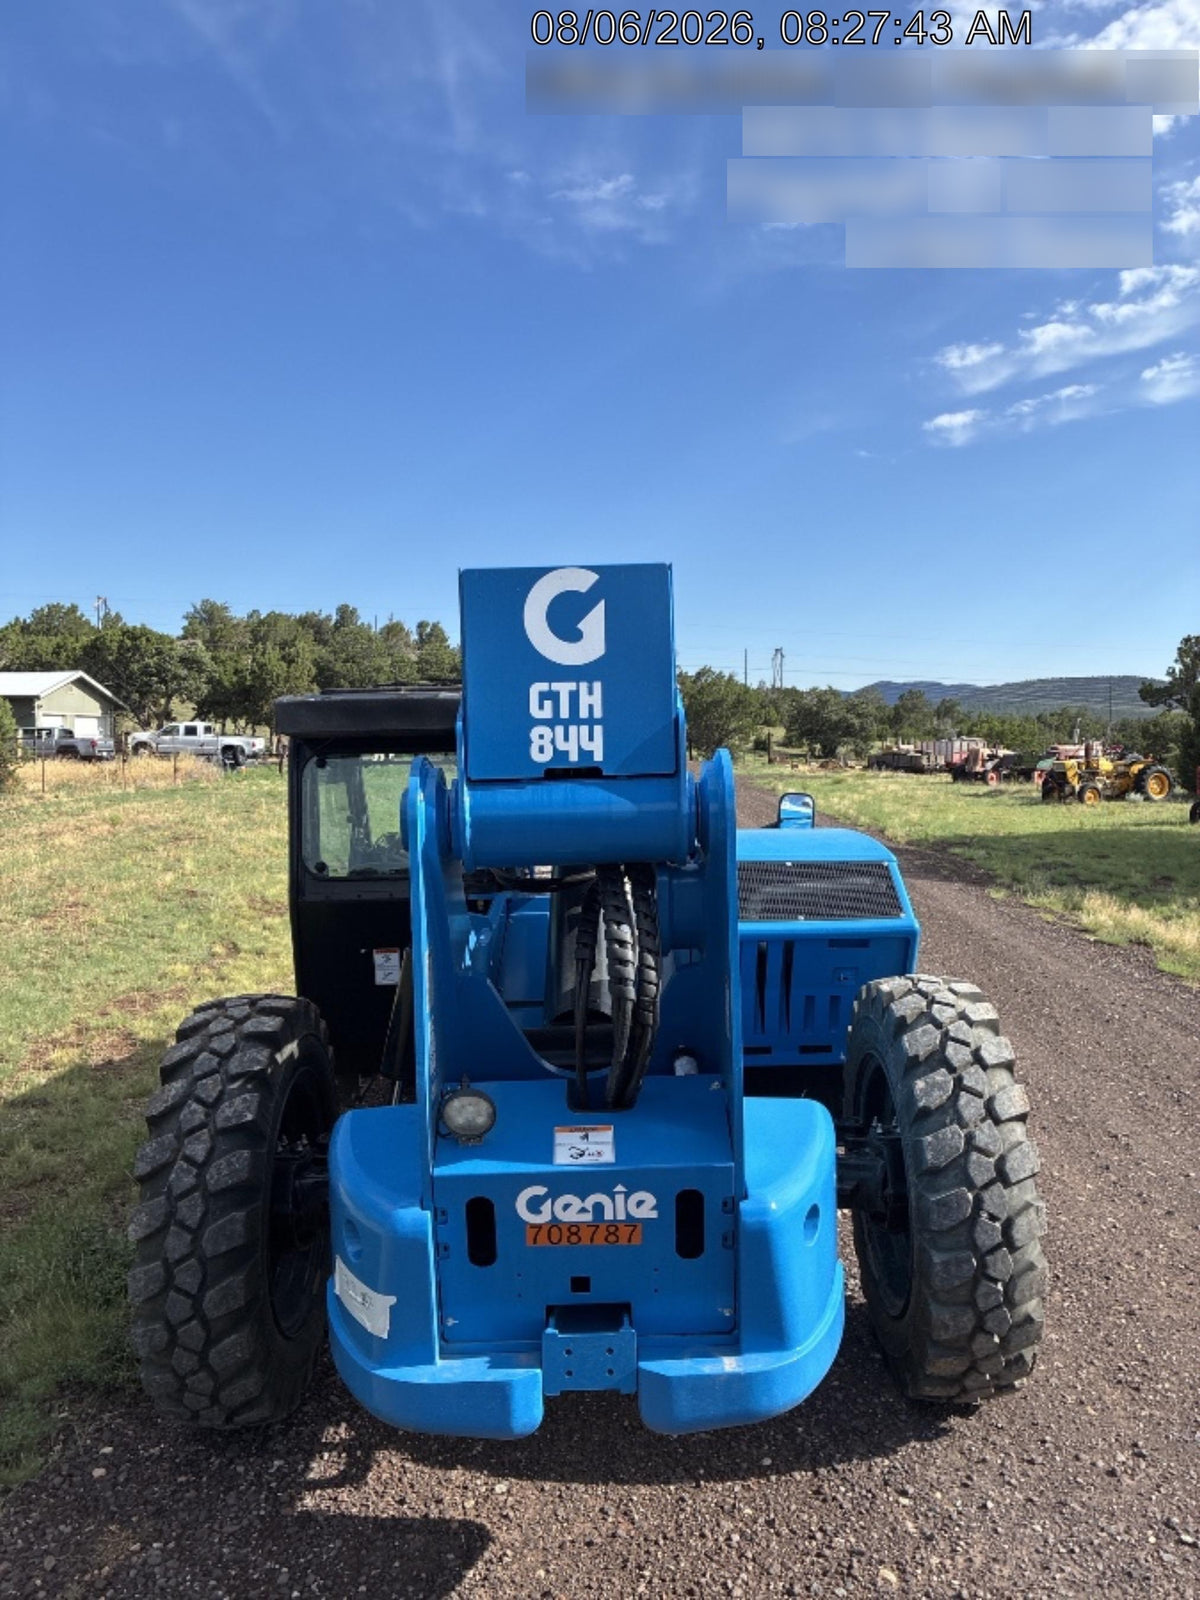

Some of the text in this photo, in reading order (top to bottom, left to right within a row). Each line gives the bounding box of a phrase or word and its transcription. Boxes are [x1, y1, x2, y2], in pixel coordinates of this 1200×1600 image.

[523, 567, 606, 665] G
[529, 681, 603, 719] GTH
[529, 725, 603, 763] 844
[515, 1184, 658, 1223] Genie
[529, 1224, 639, 1244] 708787
